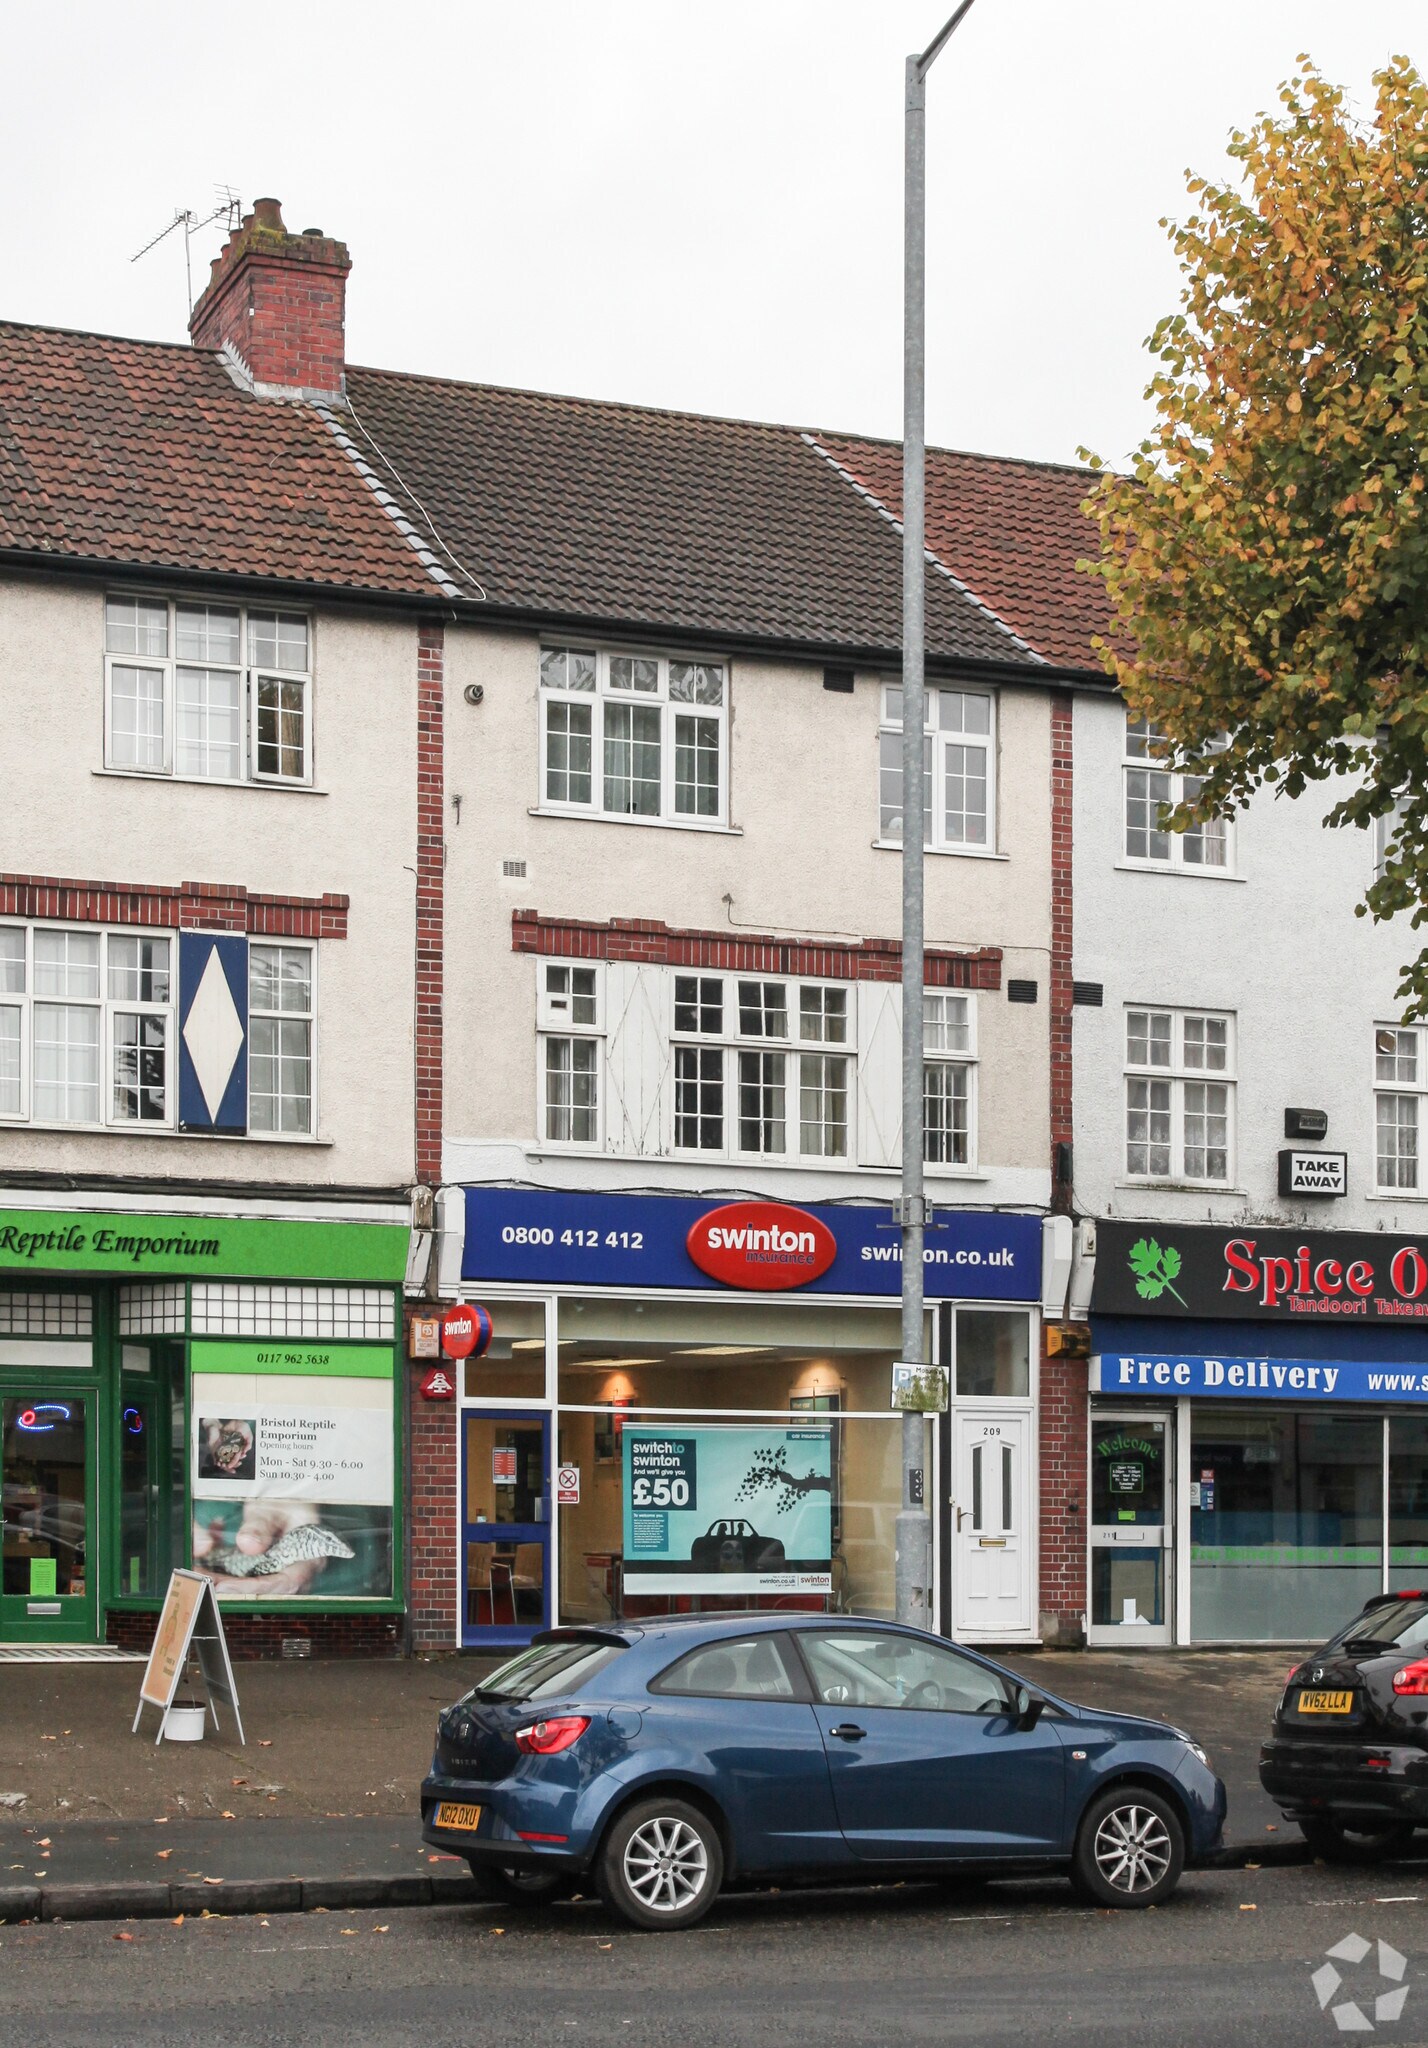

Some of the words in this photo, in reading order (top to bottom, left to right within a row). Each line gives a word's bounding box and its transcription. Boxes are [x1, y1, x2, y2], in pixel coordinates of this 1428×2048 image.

[1296, 1160, 1339, 1173] TAKE
[1294, 1175, 1342, 1188] AWAY
[0, 1225, 85, 1258] Reptile
[93, 1230, 220, 1262] Emporium
[502, 1226, 554, 1245] 0800
[560, 1229, 599, 1247] 412
[605, 1231, 644, 1249] 412
[708, 1222, 815, 1253] swinton
[746, 1252, 815, 1264] insurance
[861, 1243, 1014, 1267] swion.co.uk
[1222, 1238, 1375, 1307] Spice
[1287, 1295, 1367, 1314] Tandoori
[444, 1317, 472, 1336] swinton
[257, 1353, 282, 1363] 0117
[284, 1354, 302, 1364] 962
[304, 1354, 330, 1365] 5638
[1118, 1358, 1192, 1385] Free
[1203, 1360, 1340, 1393] Delivery
[260, 1418, 296, 1428] Bristol
[299, 1419, 337, 1430] Reptile
[260, 1430, 317, 1441] Emporium
[983, 1427, 1001, 1436] 209
[260, 1442, 291, 1450] Opening
[293, 1442, 314, 1450] hours
[1097, 1435, 1159, 1459] Welcome
[260, 1456, 283, 1466] Mon
[292, 1457, 307, 1467] Sat
[309, 1461, 332, 1470] 9.30
[341, 1459, 364, 1469] 6.00
[633, 1454, 680, 1467] swinton
[260, 1469, 278, 1479] Sun
[280, 1471, 304, 1481] 10.30
[313, 1472, 335, 1481] 4.00
[661, 1469, 674, 1477] give
[633, 1477, 690, 1506] £50
[800, 1576, 830, 1584] swinton
[1328, 1693, 1347, 1708] LLA
[439, 1805, 458, 1824] NG12
[458, 1807, 477, 1826] OXU
